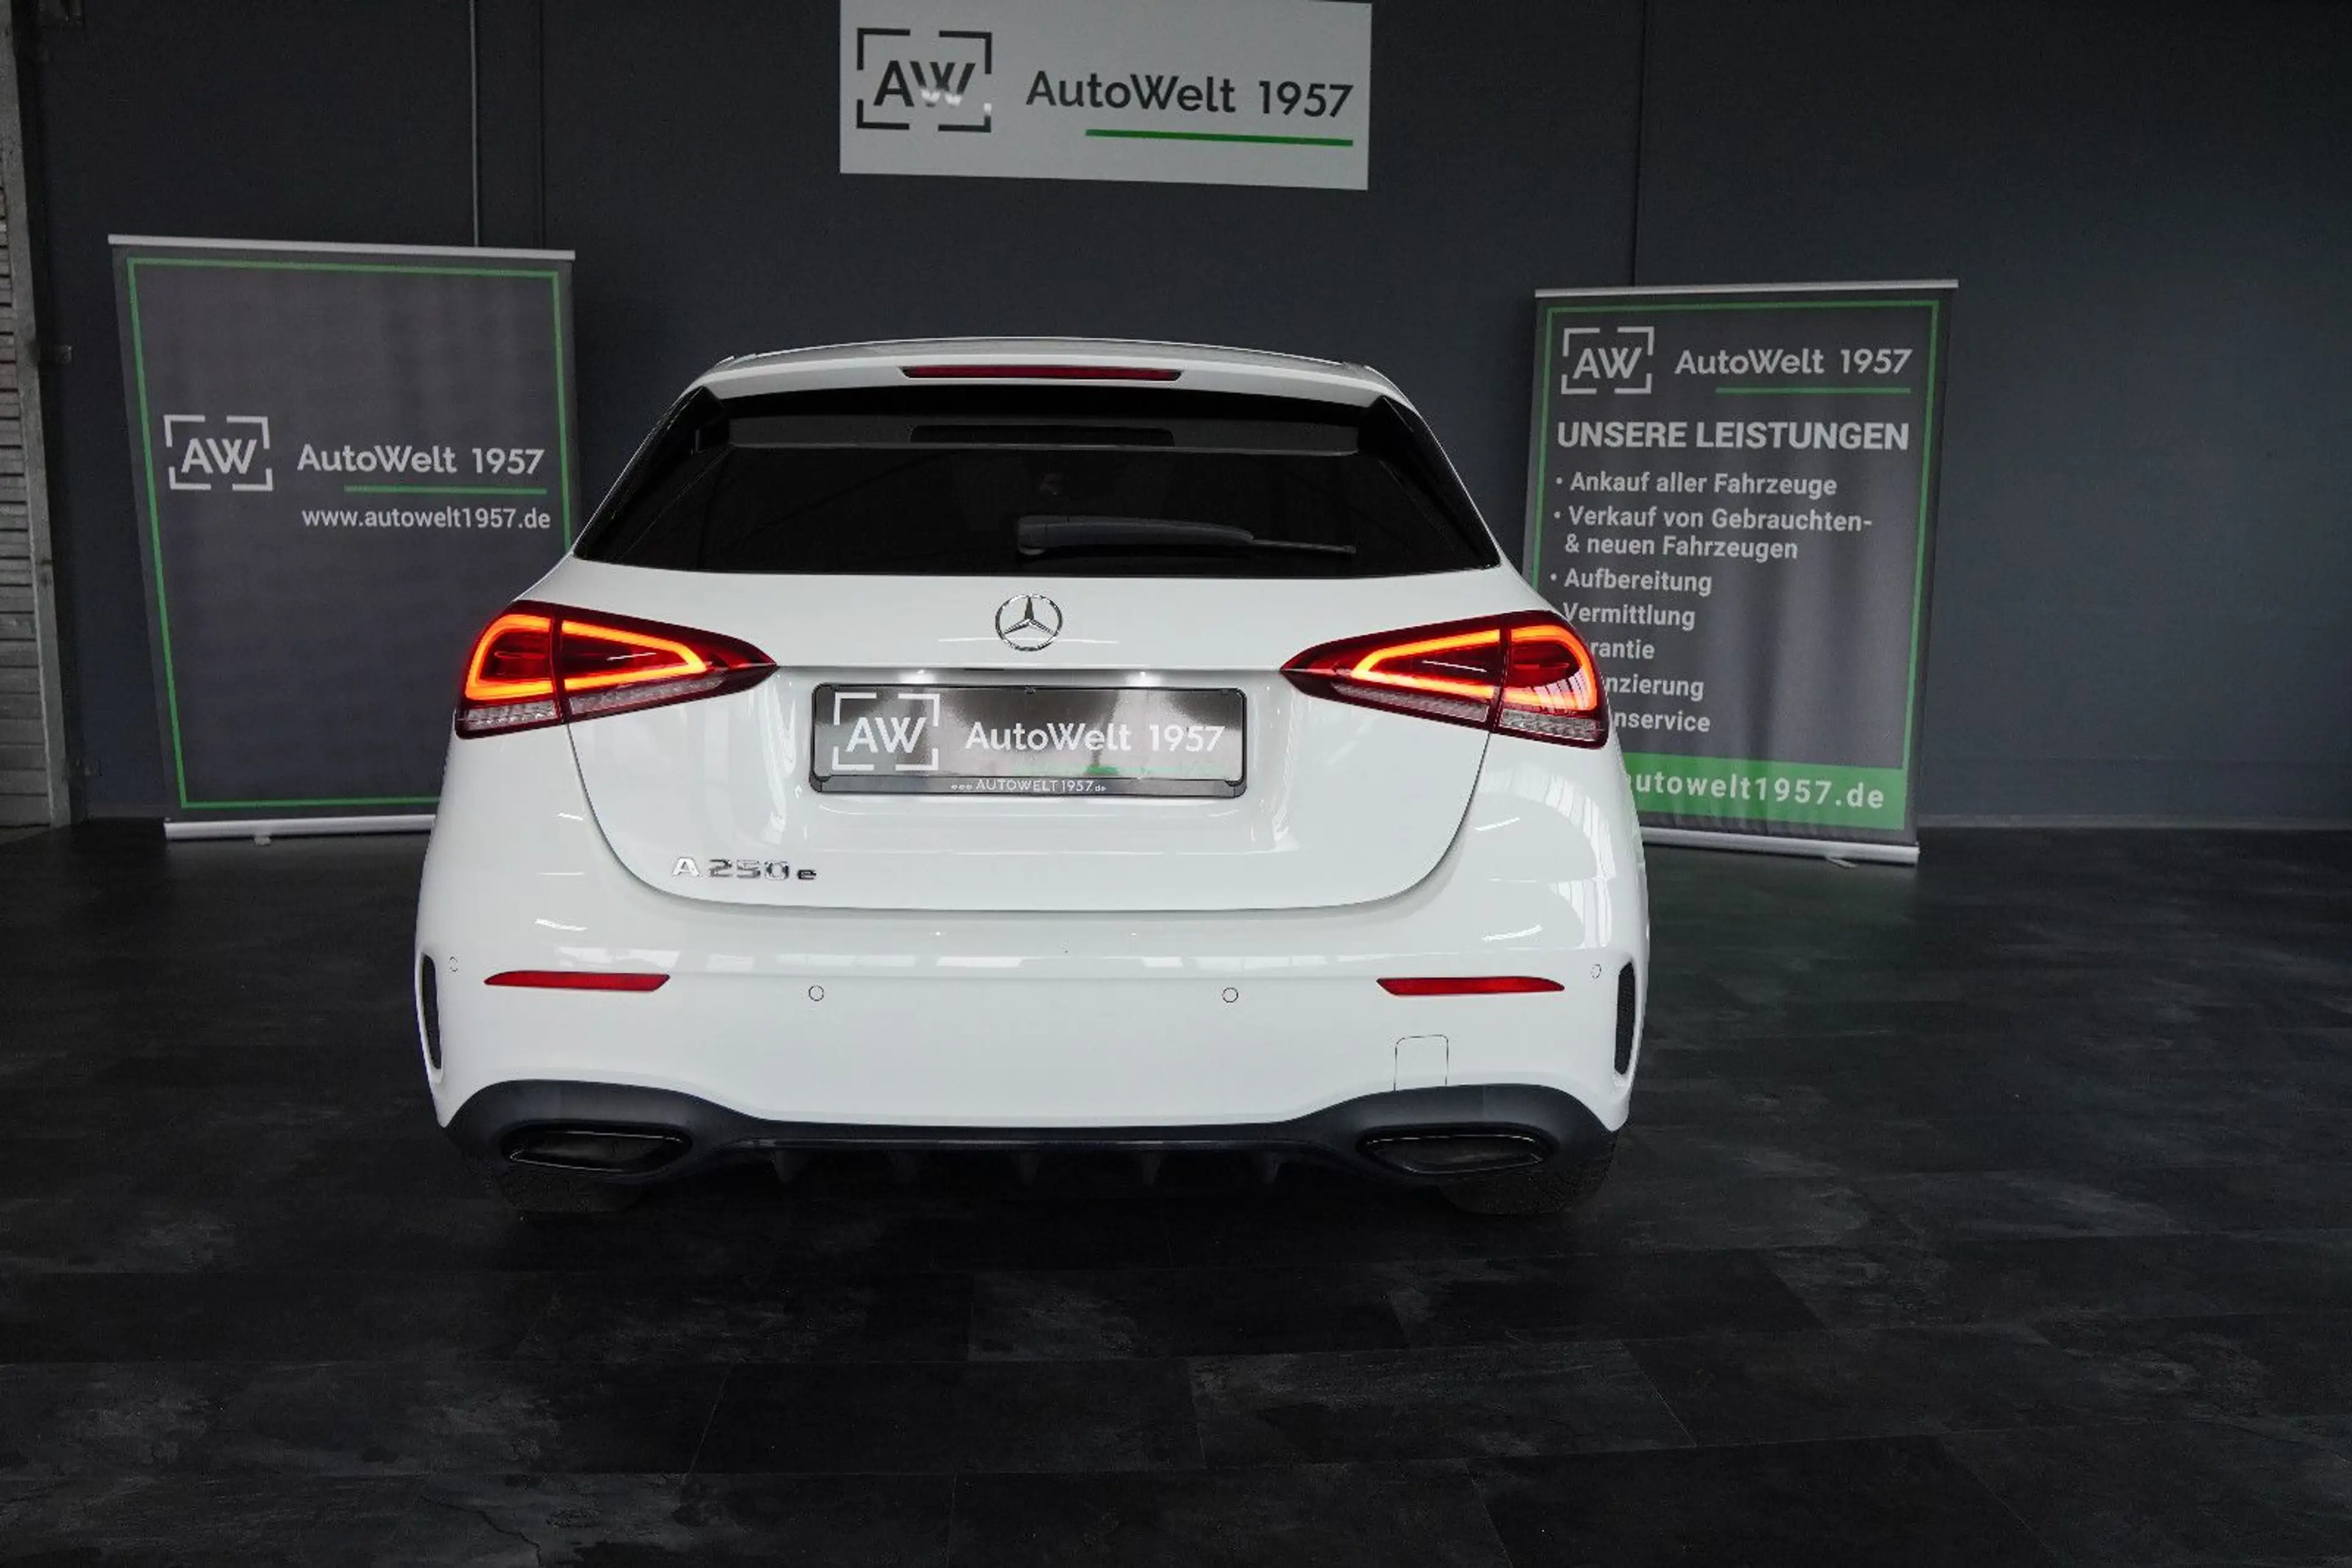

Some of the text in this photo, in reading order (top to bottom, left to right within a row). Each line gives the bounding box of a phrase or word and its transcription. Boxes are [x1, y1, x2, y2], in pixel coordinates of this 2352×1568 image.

[873, 60, 976, 107] AW
[1026, 70, 1354, 118] AutoWelt 1957
[1572, 347, 1643, 379] AW
[1675, 348, 1913, 375] AutoWelt 1957
[1558, 421, 1909, 451] UNSERE LEISTUNGEN
[181, 437, 257, 474] AW
[297, 443, 545, 475] AutoWelt 1957
[1569, 470, 1838, 500] Ankauf aller Fahrzeuge
[301, 505, 551, 529] www.autowelt1957.de
[1568, 505, 1873, 532] Verkauf von Gebrauchten-
[1564, 532, 1799, 564] & neuen Fahrzeugen
[1563, 567, 1713, 597] Aufbereitung
[1562, 601, 1696, 632] Vermittlung
[1589, 638, 1656, 660] rantie
[1604, 673, 1705, 702] nzierung
[845, 716, 927, 754] AW
[1613, 709, 1711, 733] nservice
[965, 722, 1226, 753] AutoWelt 1957
[1627, 770, 1885, 810] utowelt1957.de
[672, 856, 700, 877] A
[708, 858, 790, 880] 250
